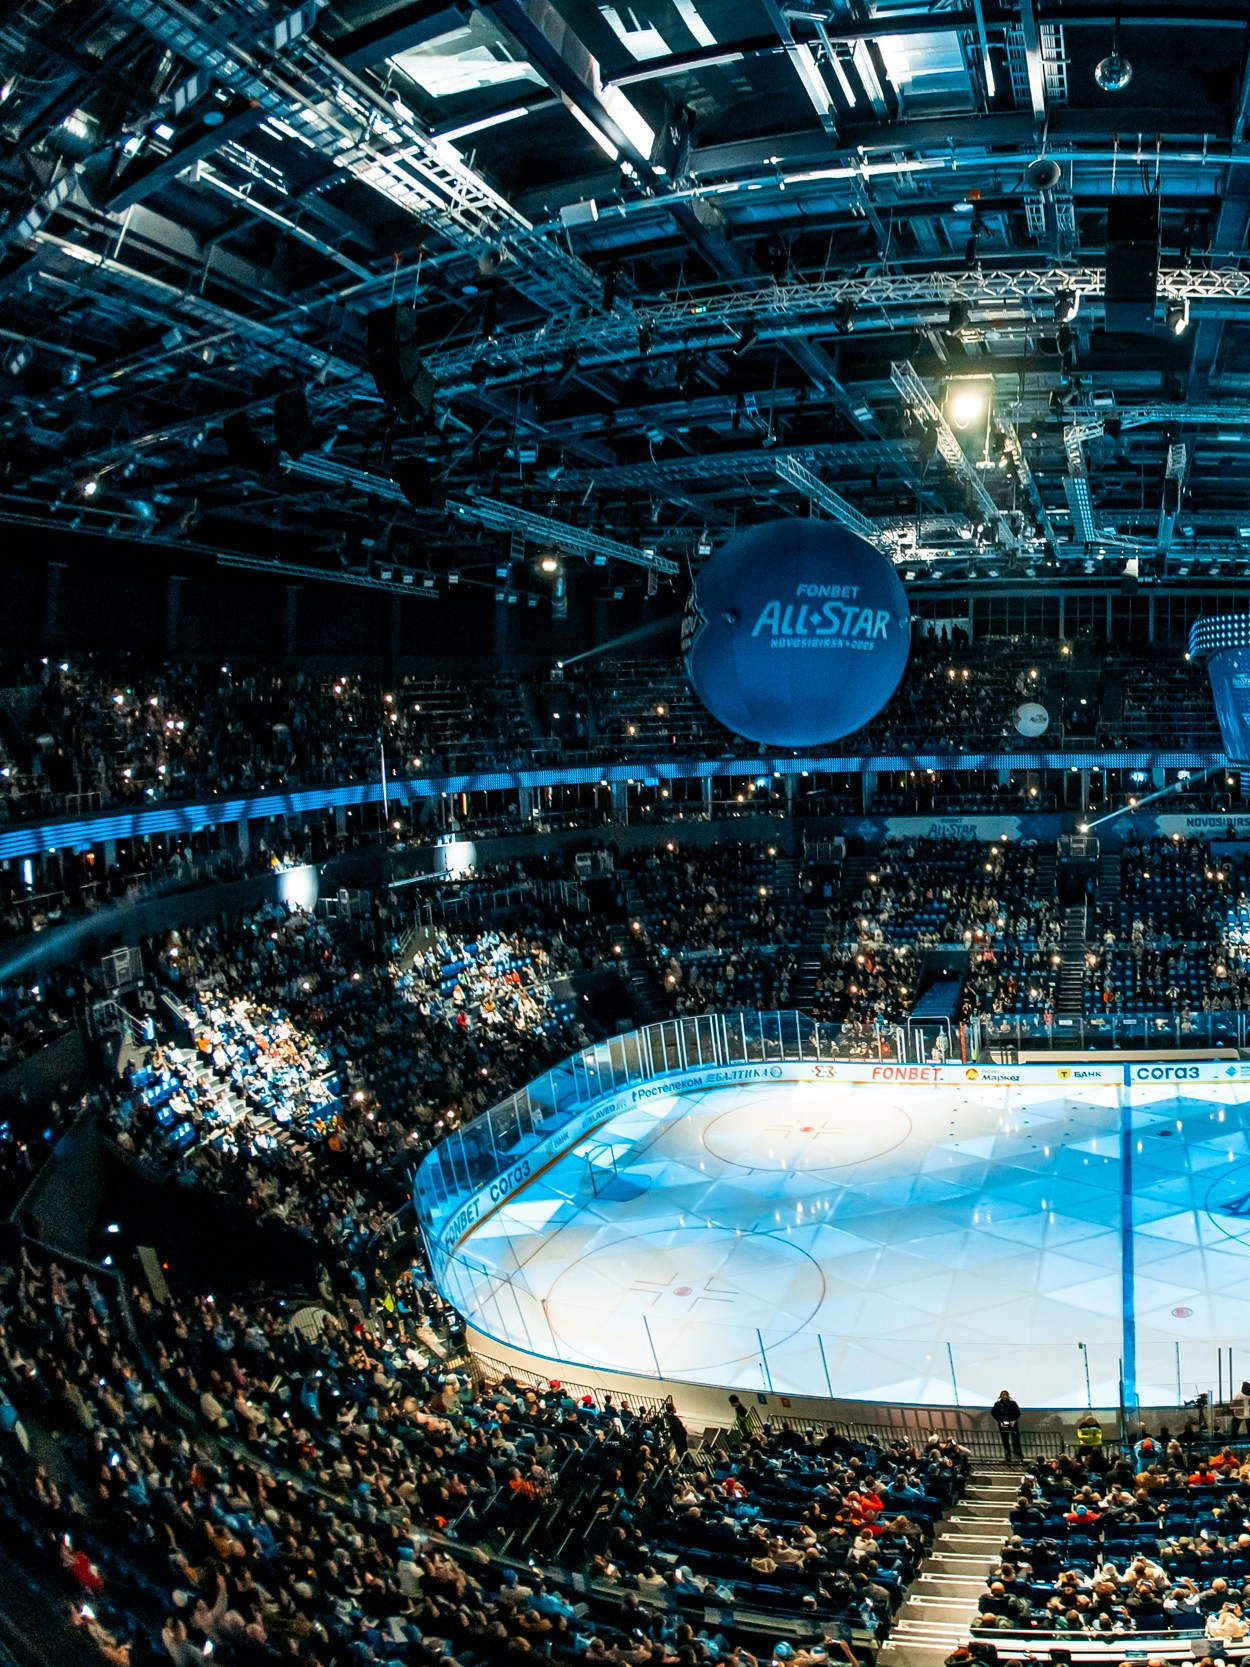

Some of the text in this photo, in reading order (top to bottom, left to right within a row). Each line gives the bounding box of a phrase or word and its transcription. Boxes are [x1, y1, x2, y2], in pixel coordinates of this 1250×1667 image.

[797, 583, 859, 599] FONBET
[770, 637, 843, 648] NOVOSIBIRSK
[715, 1068, 768, 1083] БАЛТИКА
[872, 1066, 942, 1081] FONBET
[638, 1078, 703, 1100] Ростелеком
